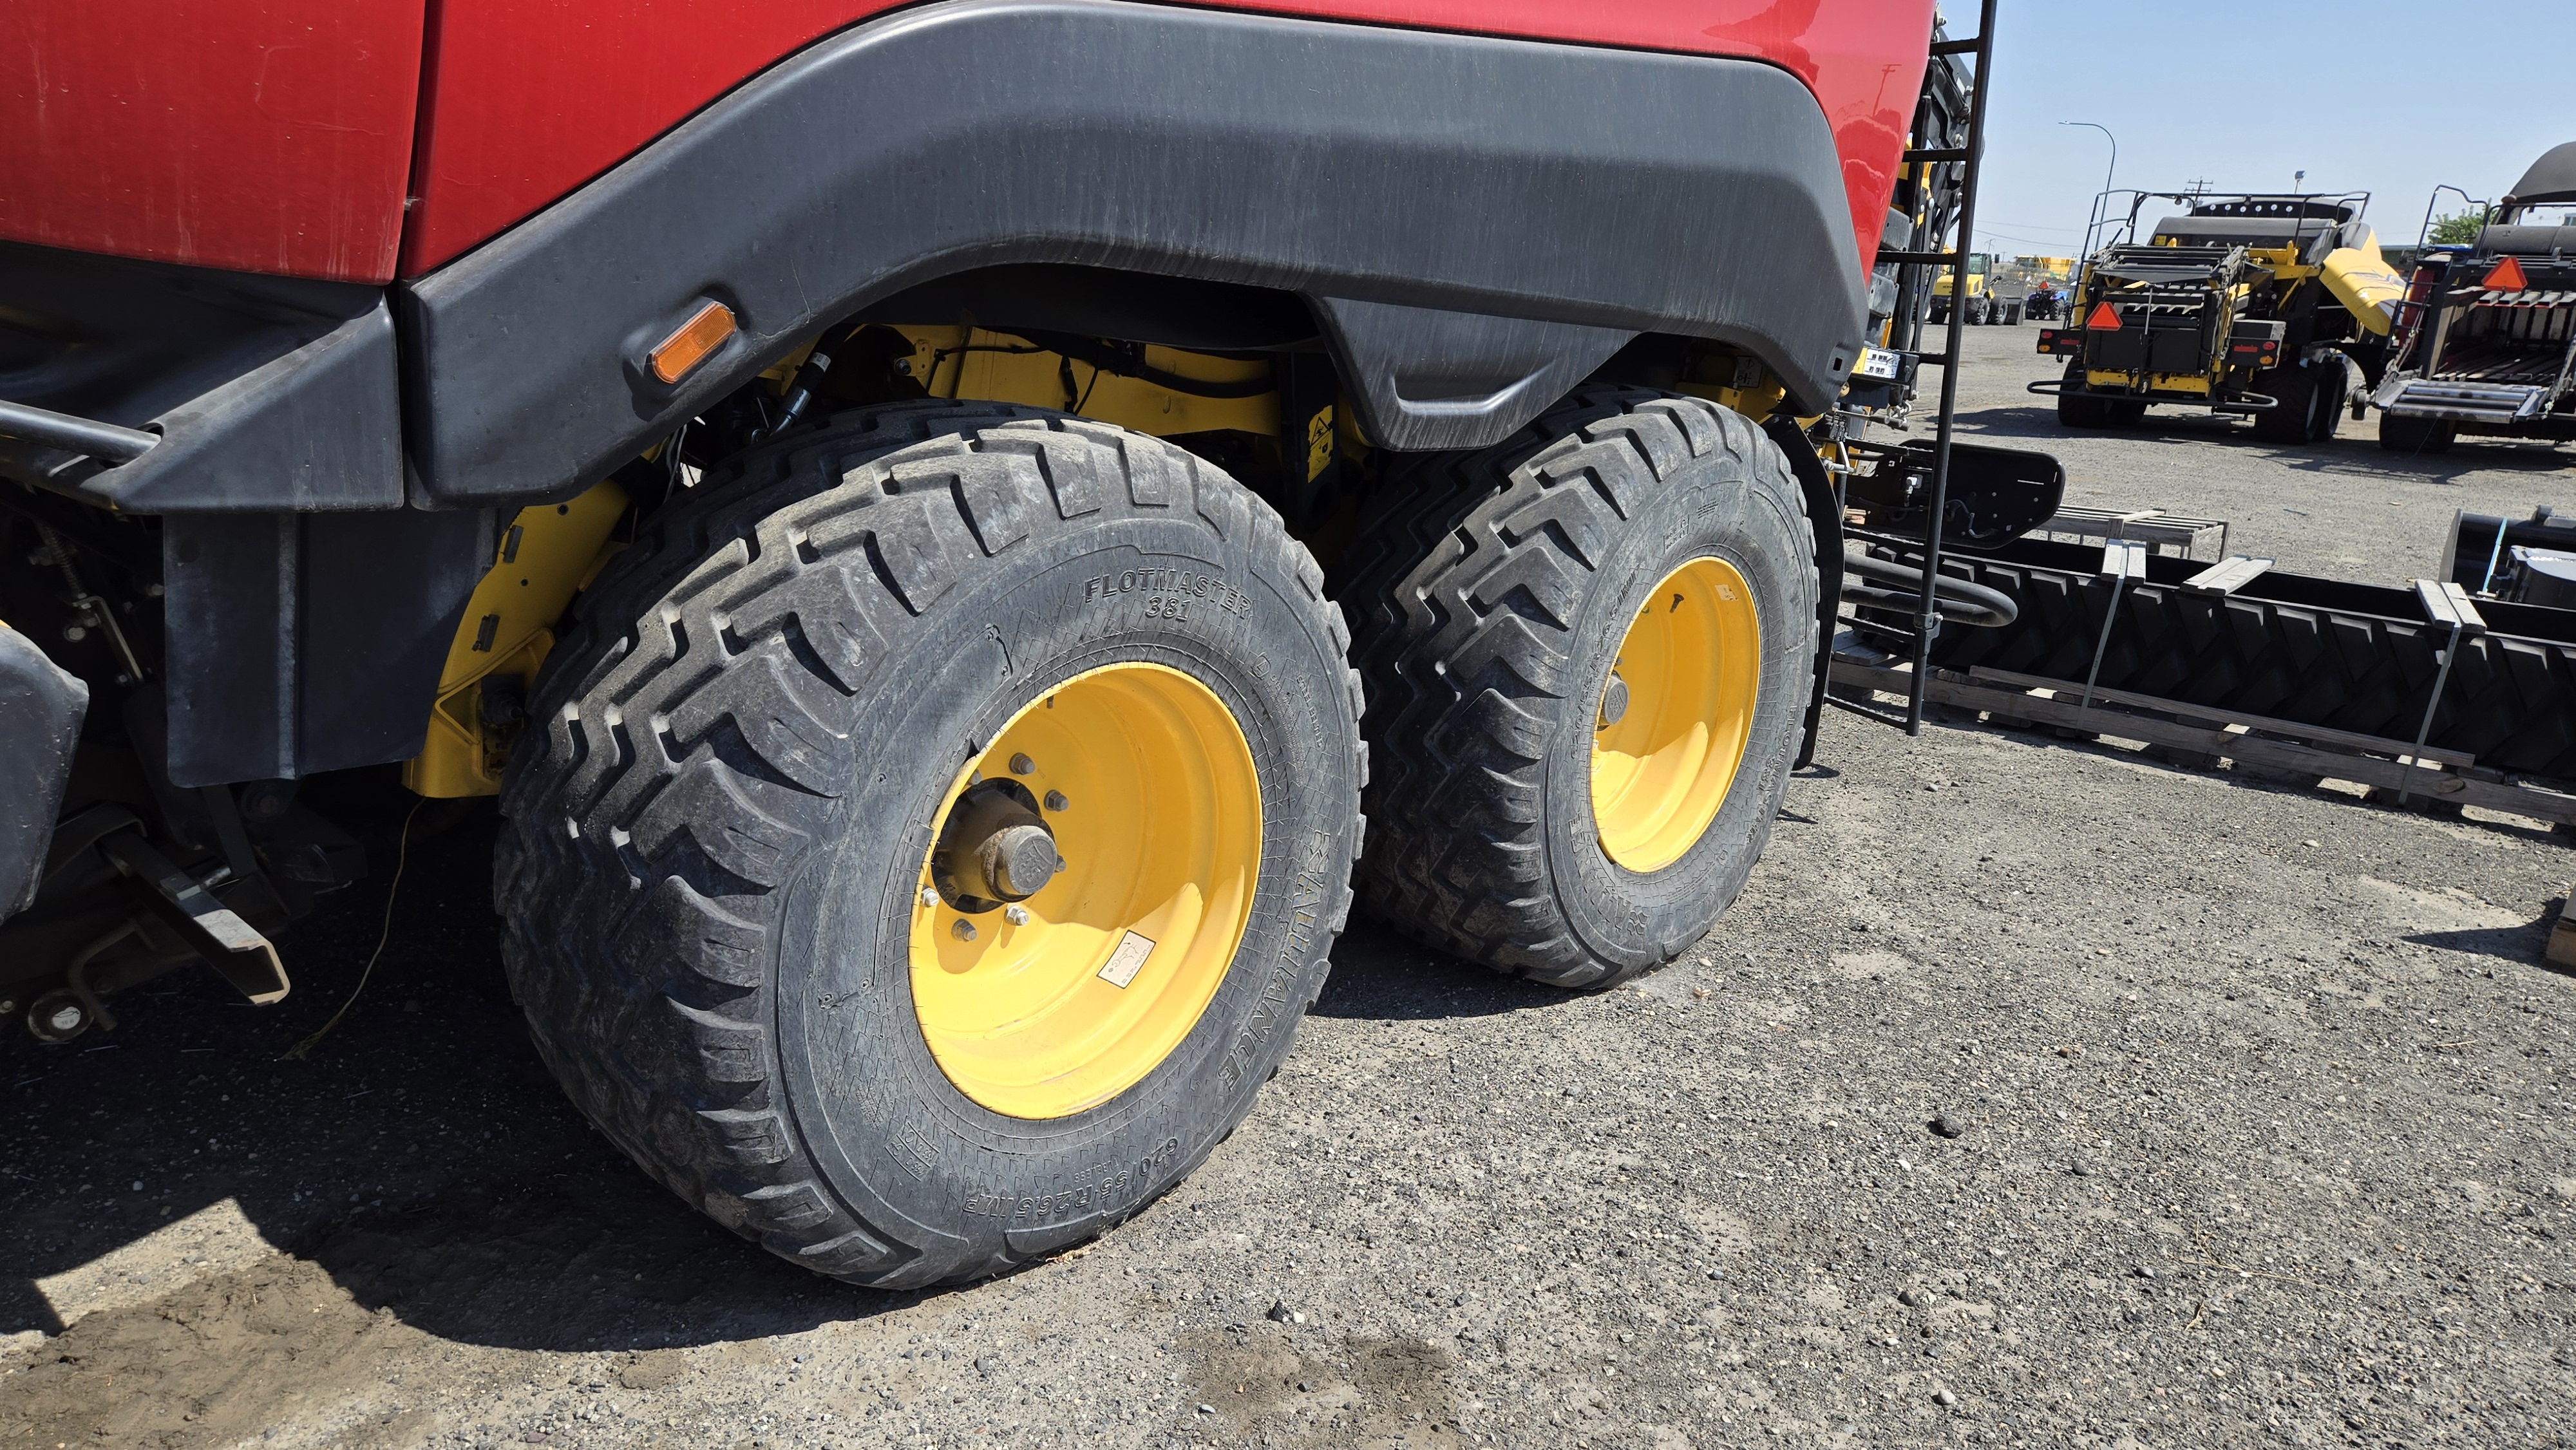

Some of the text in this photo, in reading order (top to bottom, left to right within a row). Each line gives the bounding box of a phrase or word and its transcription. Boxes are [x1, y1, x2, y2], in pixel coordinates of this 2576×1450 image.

[1084, 567, 1252, 620] FLOTMASTER
[1146, 596, 1191, 621] 381
[1218, 872, 1323, 1091] ALLIANCE
